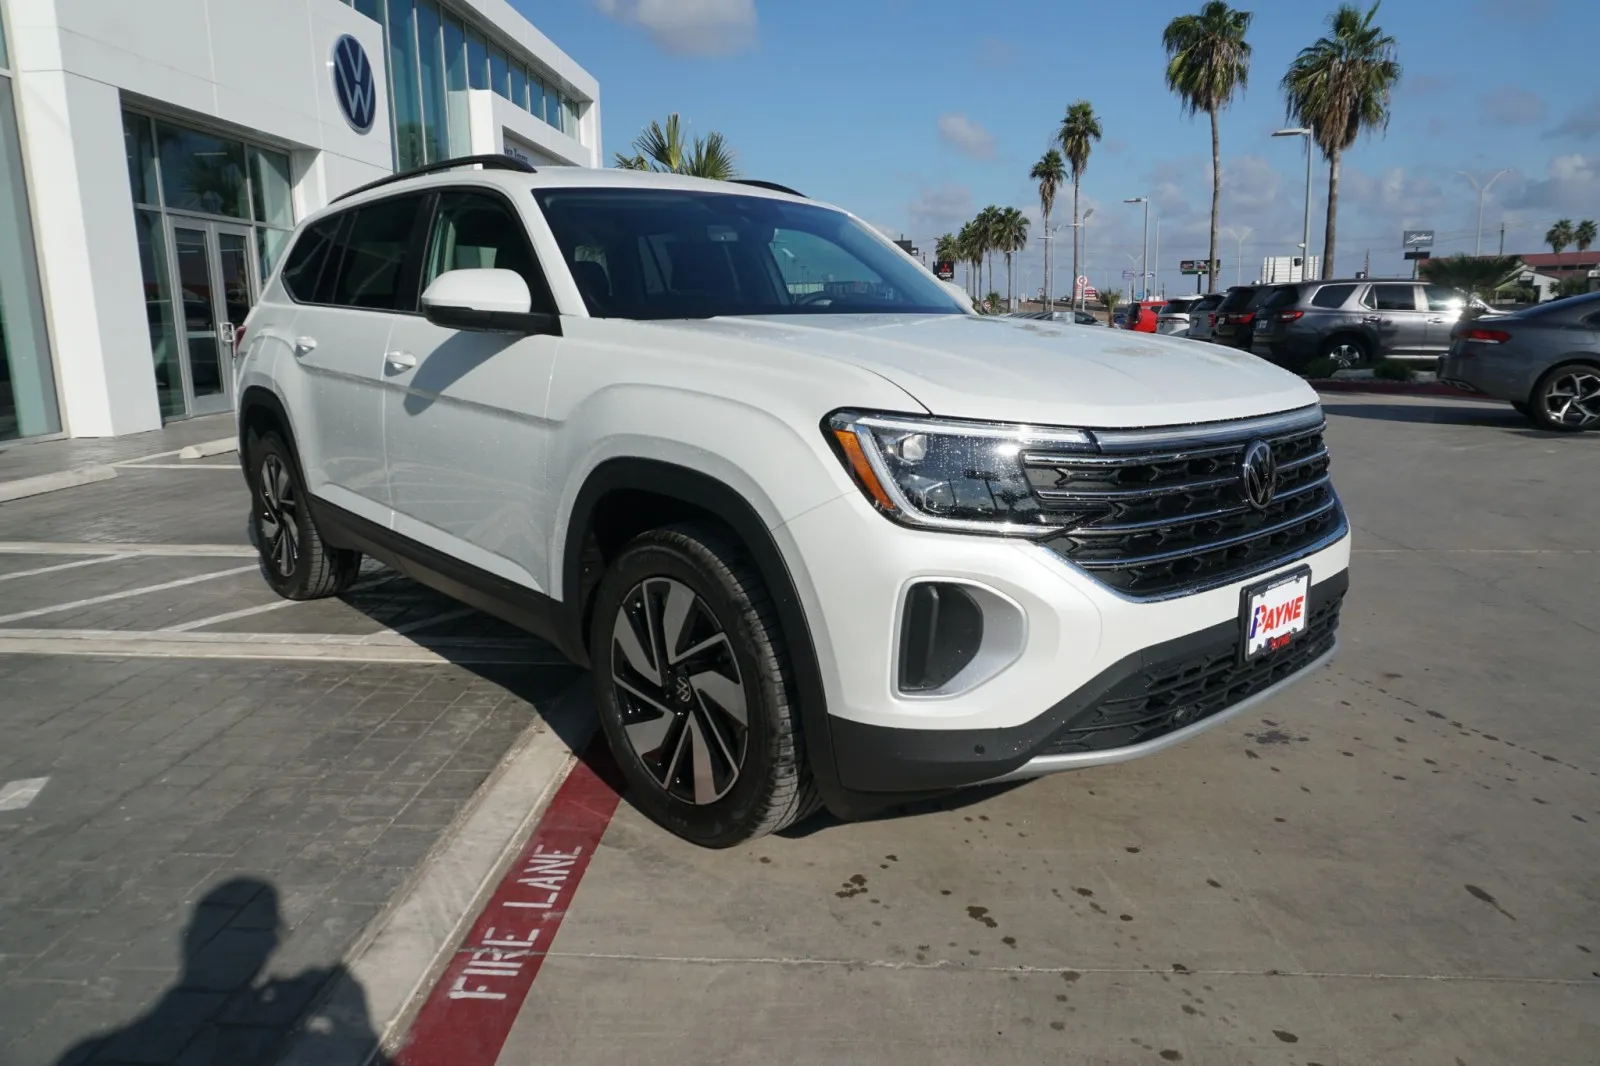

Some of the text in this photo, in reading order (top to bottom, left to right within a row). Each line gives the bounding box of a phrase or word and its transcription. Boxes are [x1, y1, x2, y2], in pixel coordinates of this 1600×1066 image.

[333, 35, 375, 127] VW
[1250, 595, 1304, 640] PAYNE
[450, 844, 582, 1000] FIRE LANE
